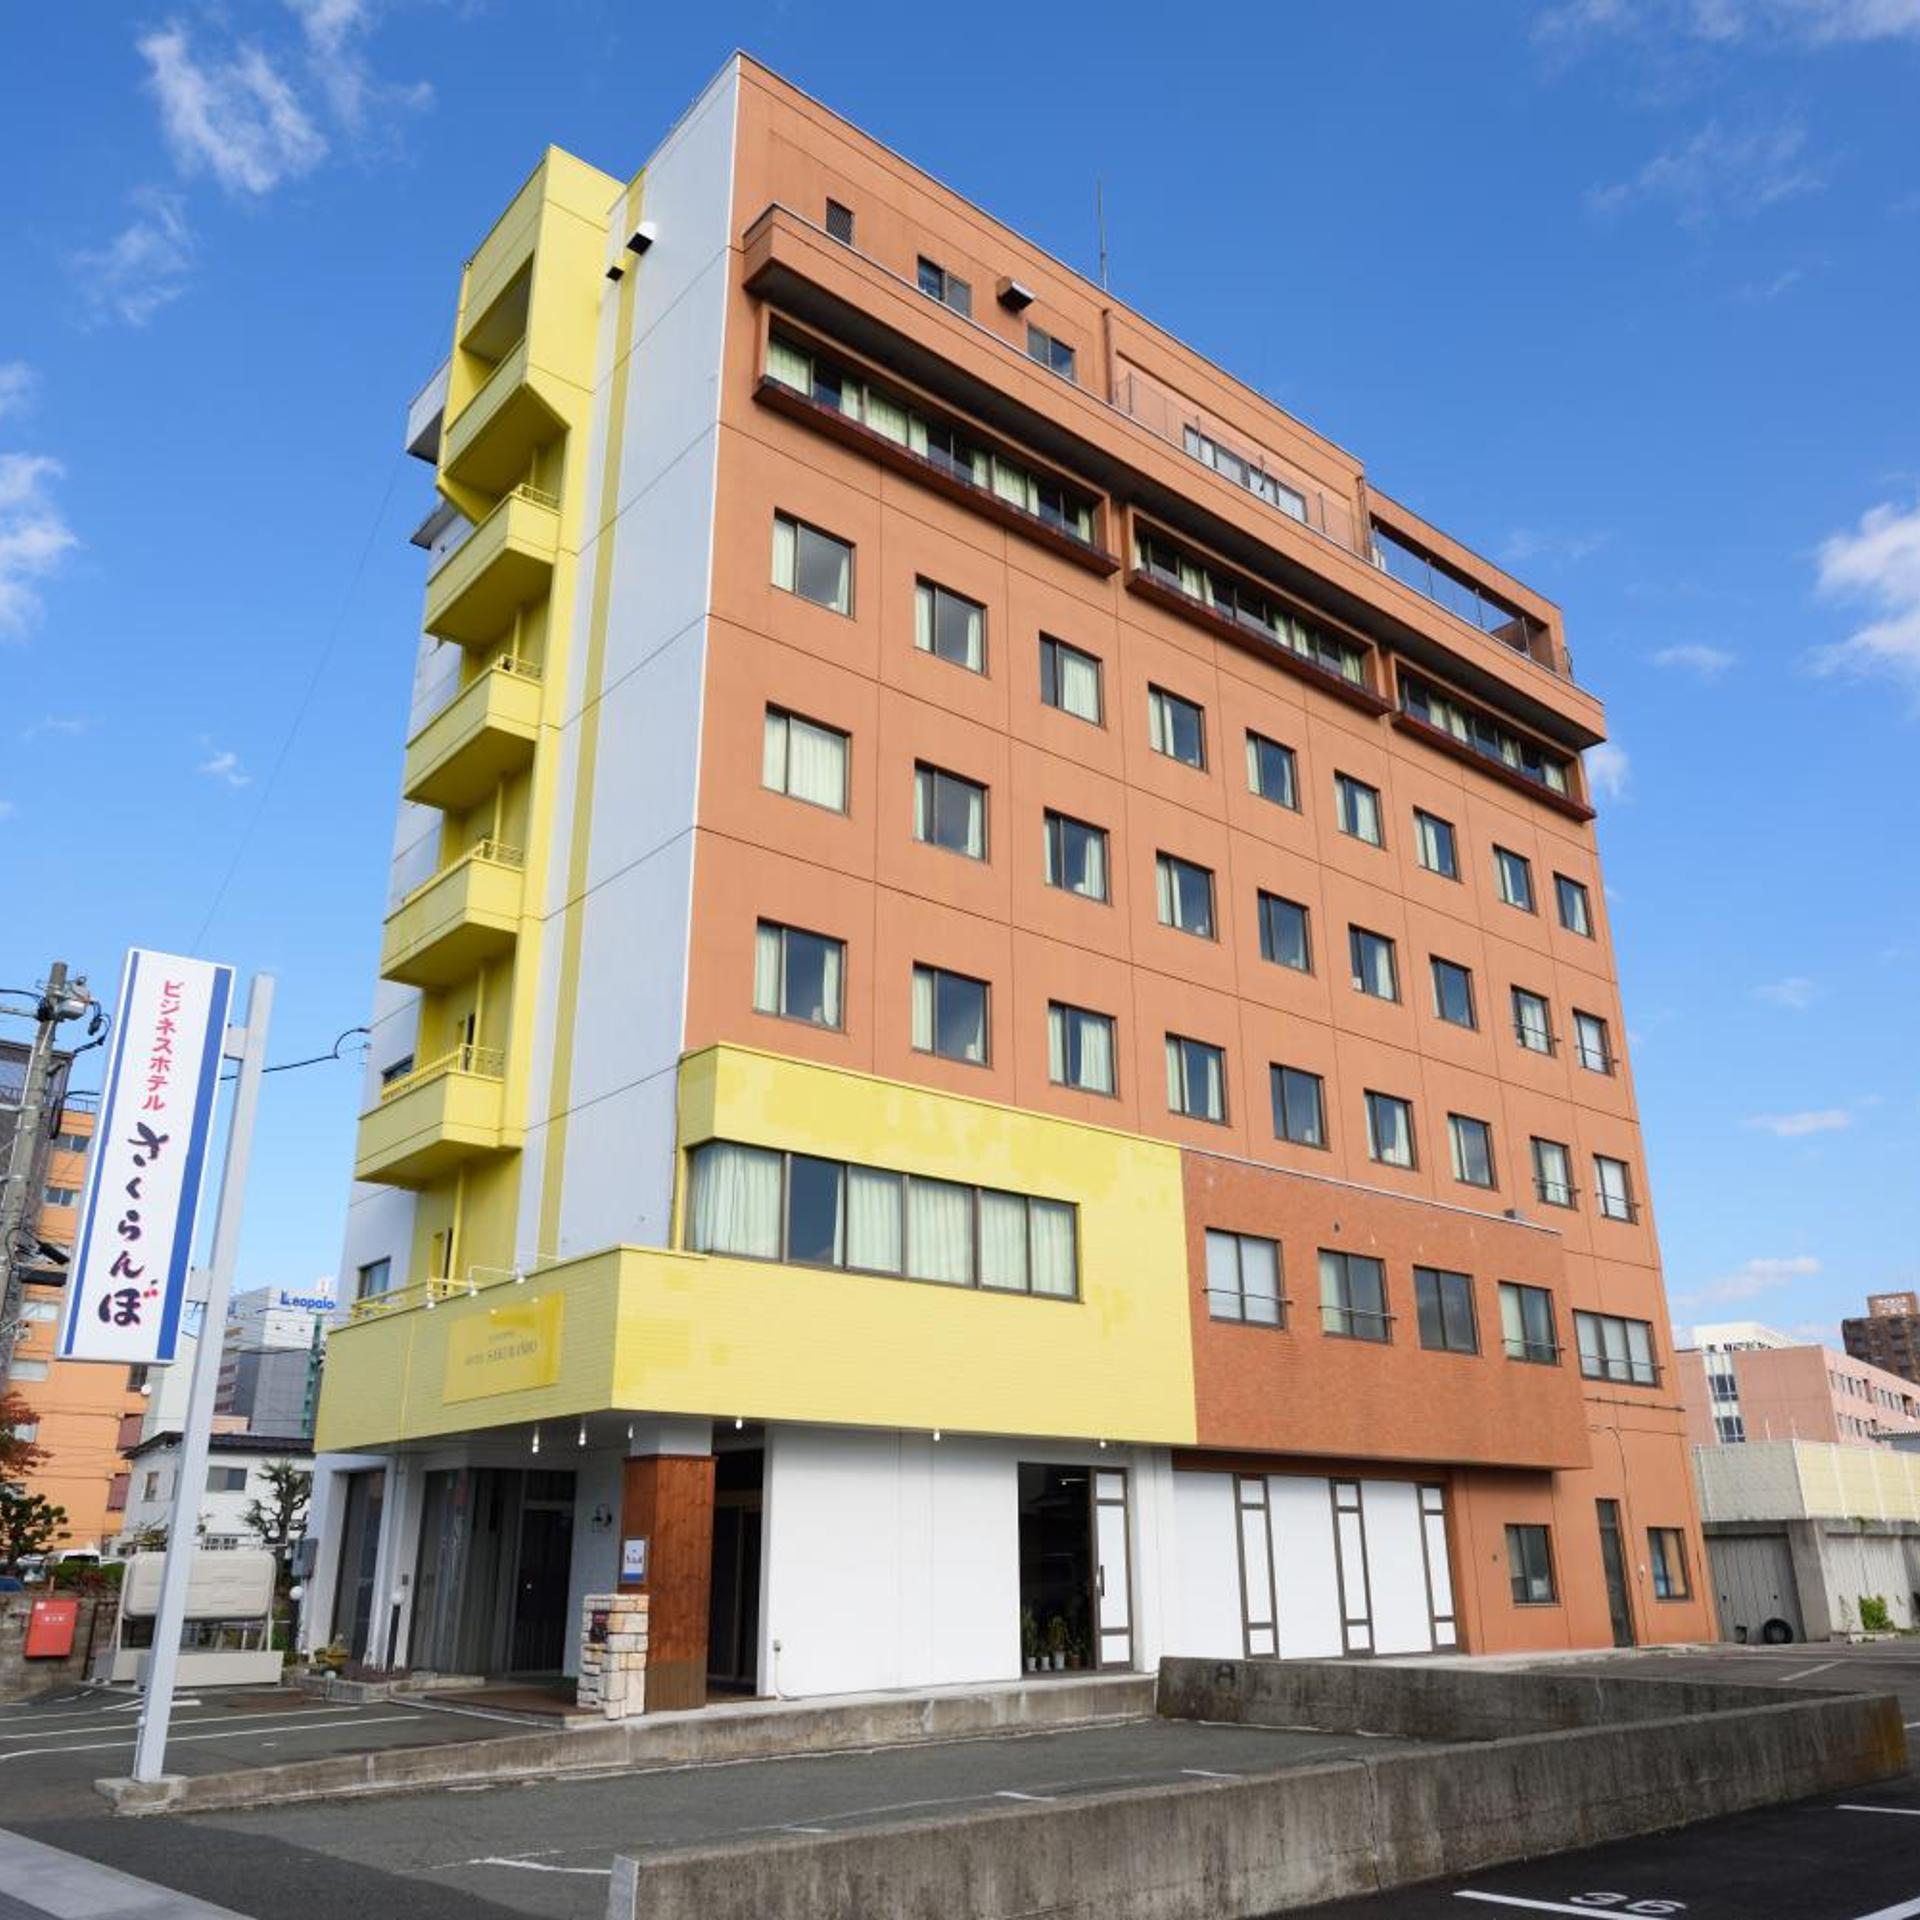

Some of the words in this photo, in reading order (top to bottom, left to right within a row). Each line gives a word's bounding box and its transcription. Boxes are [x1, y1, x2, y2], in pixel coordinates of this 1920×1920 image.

[142, 979, 185, 1111] ビジネスホテル
[98, 1121, 170, 1327] さくらんぼ
[1569, 1892, 1687, 1914] 36
